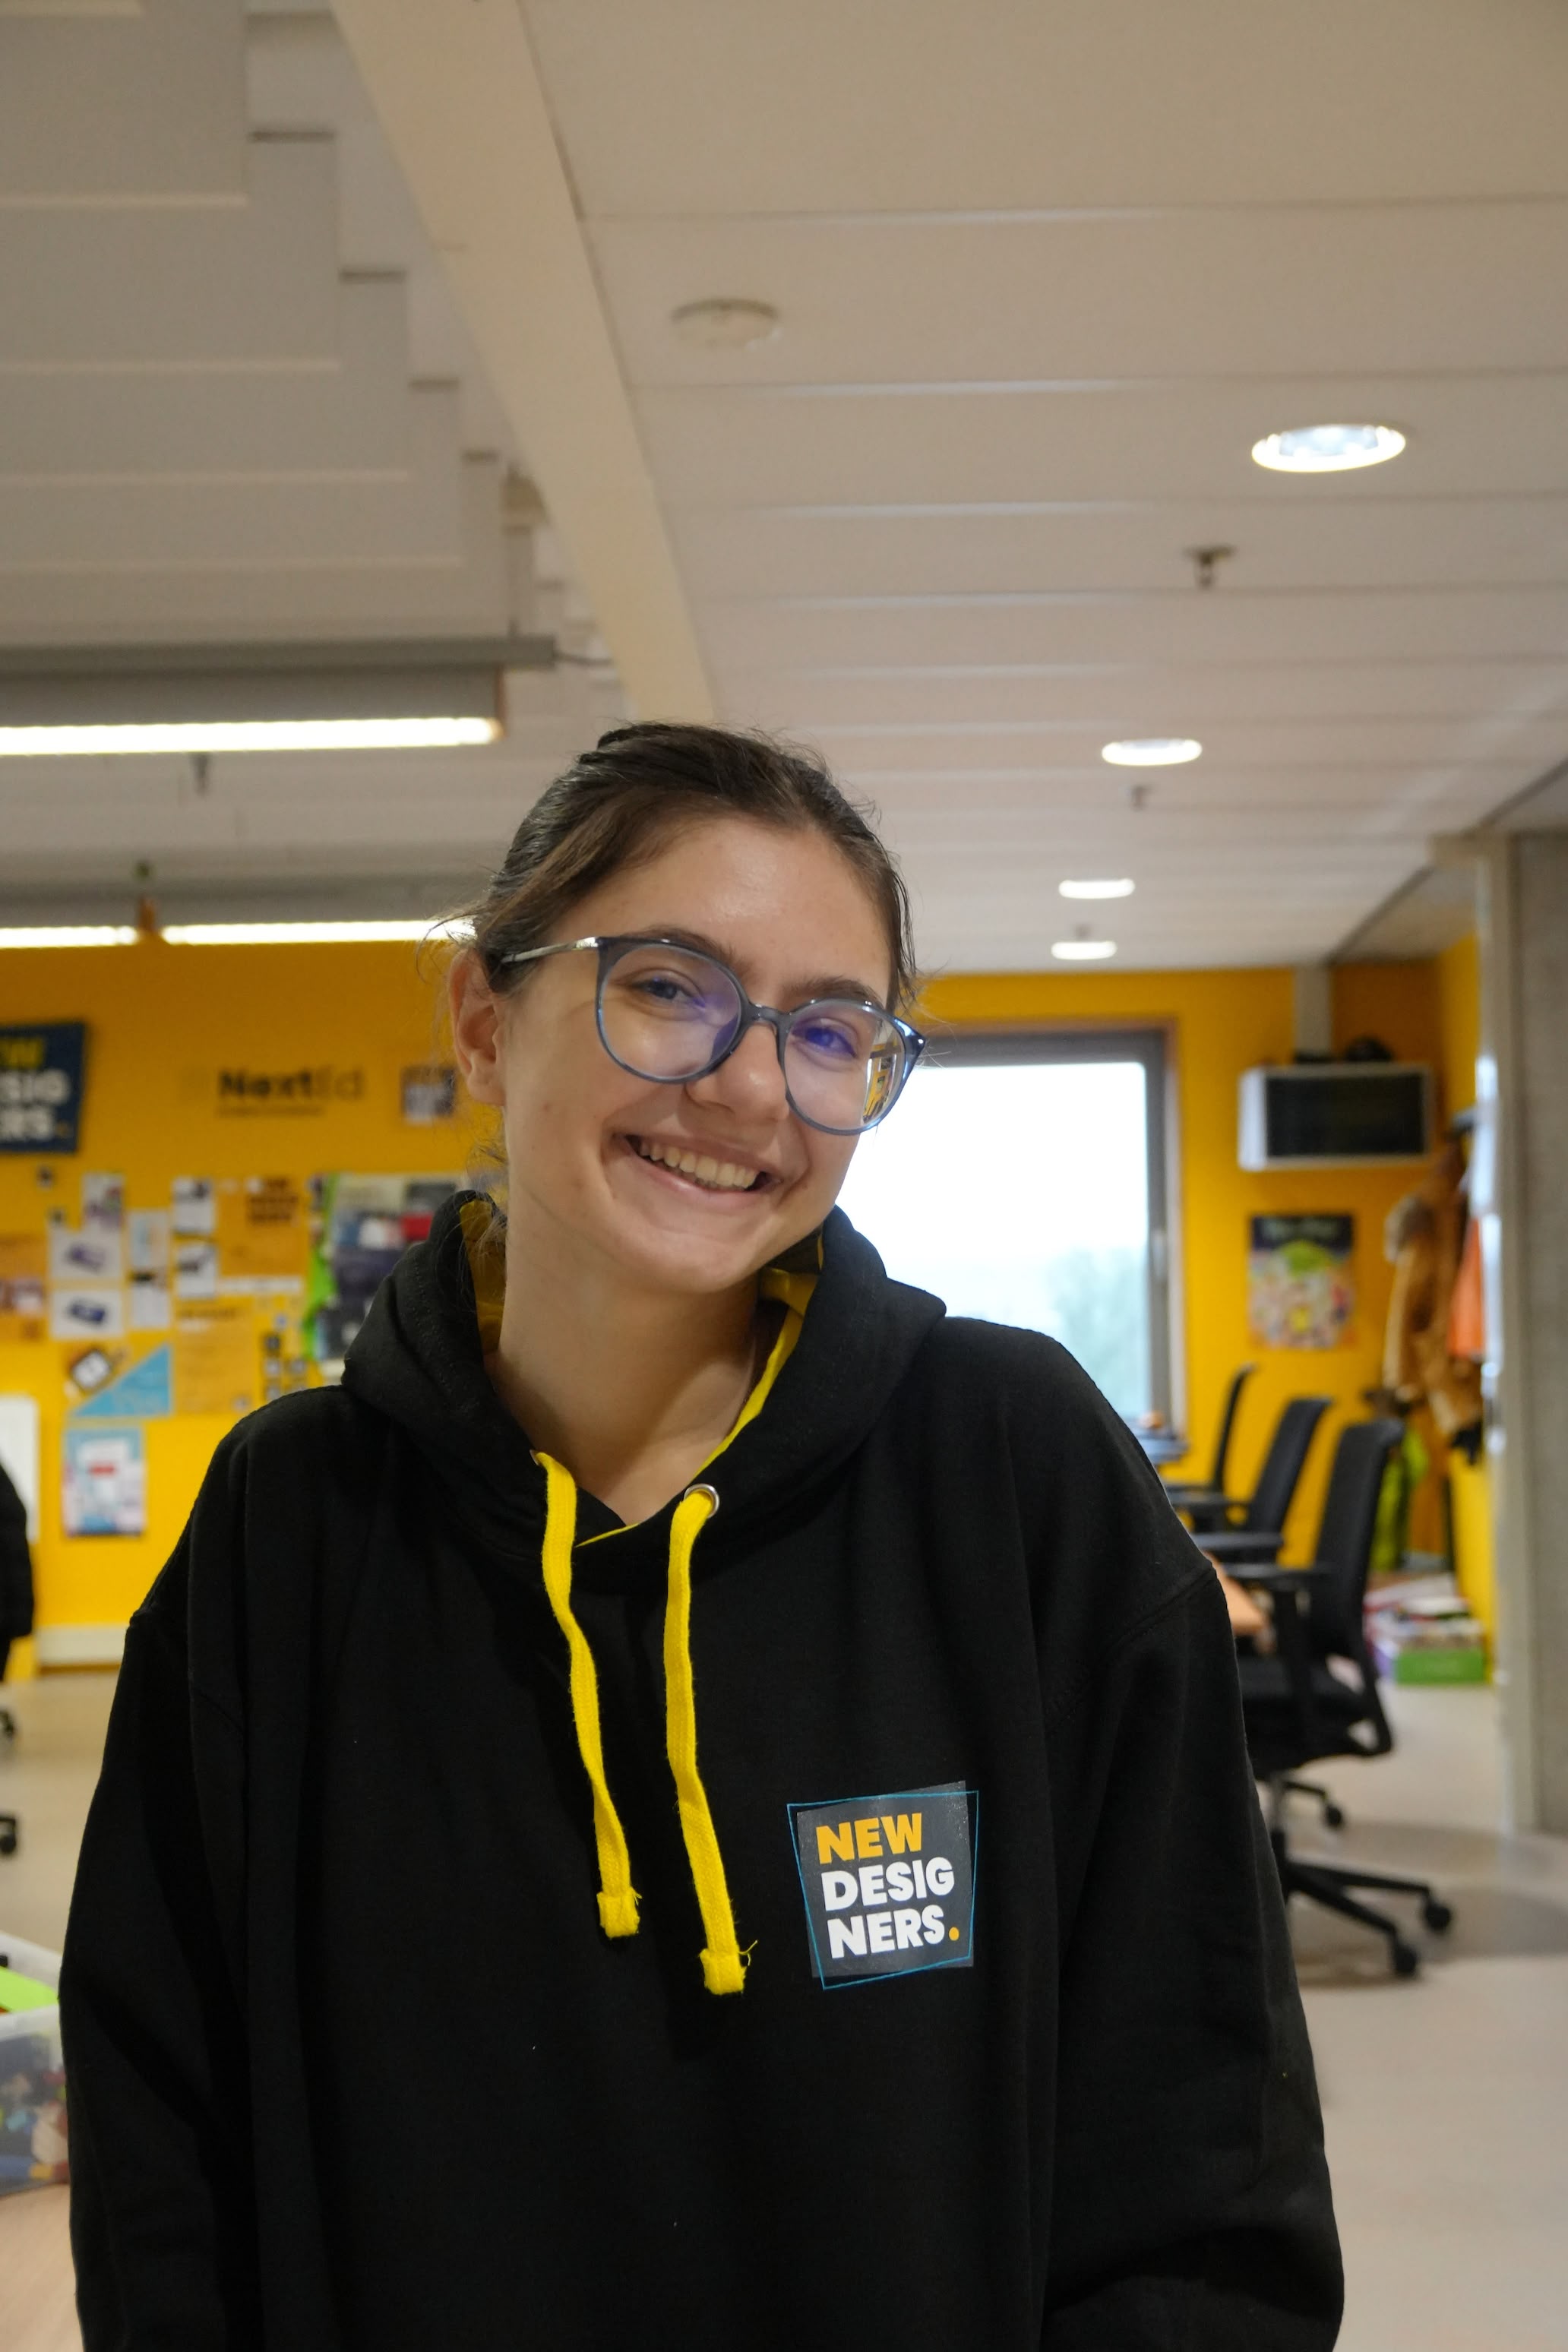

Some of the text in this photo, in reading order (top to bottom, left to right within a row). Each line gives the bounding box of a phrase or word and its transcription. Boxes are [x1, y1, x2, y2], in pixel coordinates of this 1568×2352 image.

[816, 1813, 922, 1864] NEW
[821, 1857, 955, 1911] DESIG
[827, 1905, 959, 1958] NERS.
